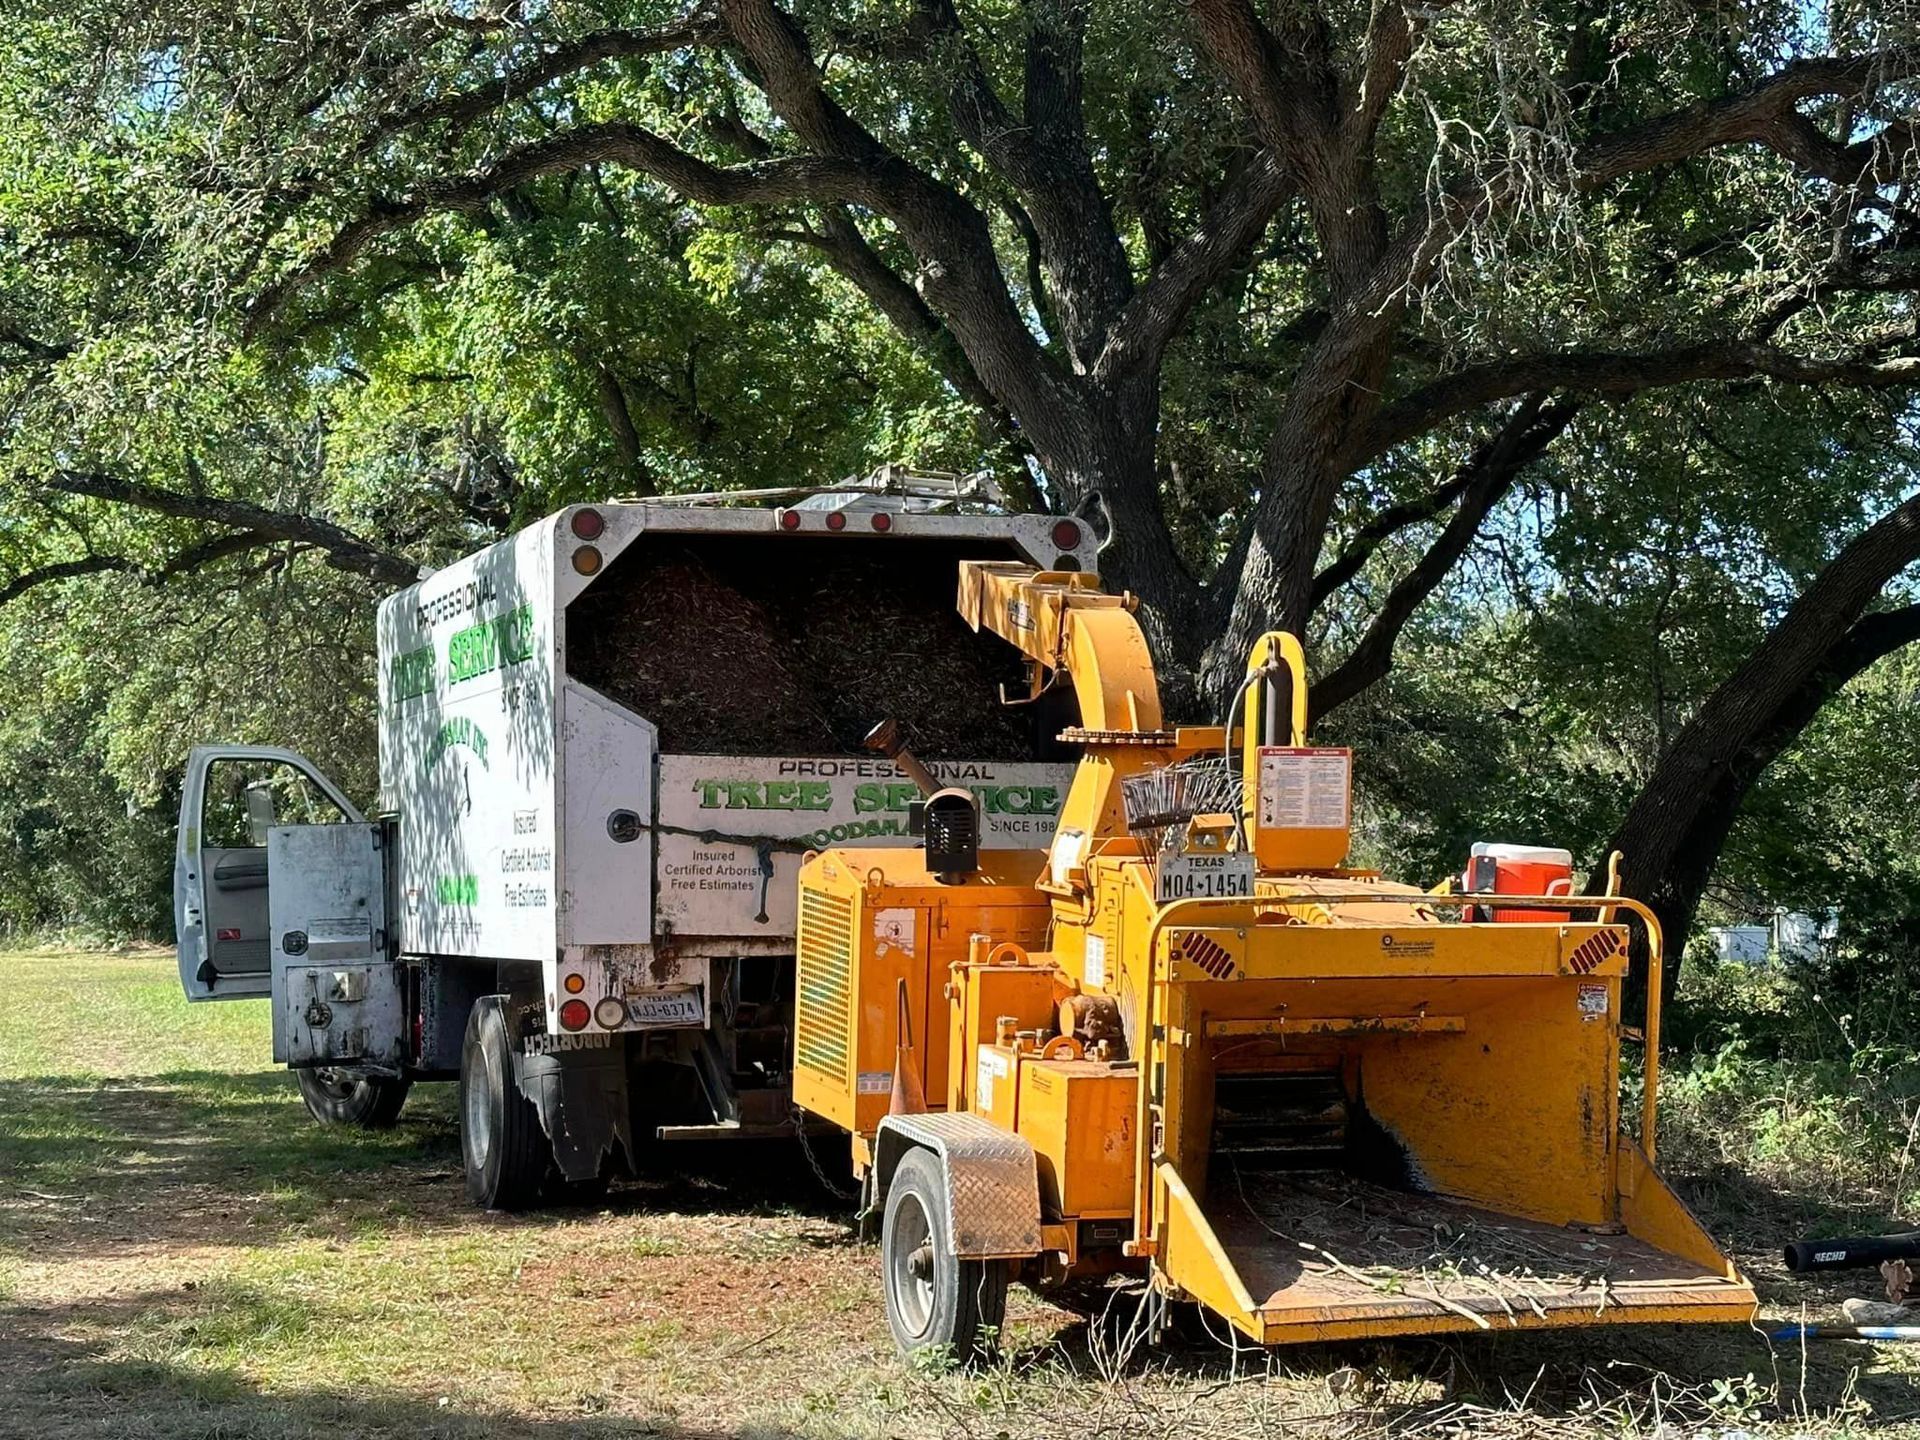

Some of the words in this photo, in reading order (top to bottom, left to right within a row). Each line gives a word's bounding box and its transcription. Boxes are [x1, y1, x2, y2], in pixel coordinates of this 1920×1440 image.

[779, 761, 995, 780] PROFESSONAL
[692, 779, 833, 812] TREE
[854, 782, 1061, 816] SEICE
[1035, 820, 1056, 832] 198
[692, 850, 735, 861] Insured
[1187, 857, 1225, 867] TEXAS
[665, 864, 713, 876] Certified
[716, 865, 762, 876] Arborist
[671, 879, 696, 890] Free
[700, 879, 754, 891] Estimates
[1820, 1250, 1847, 1262] ECHO
